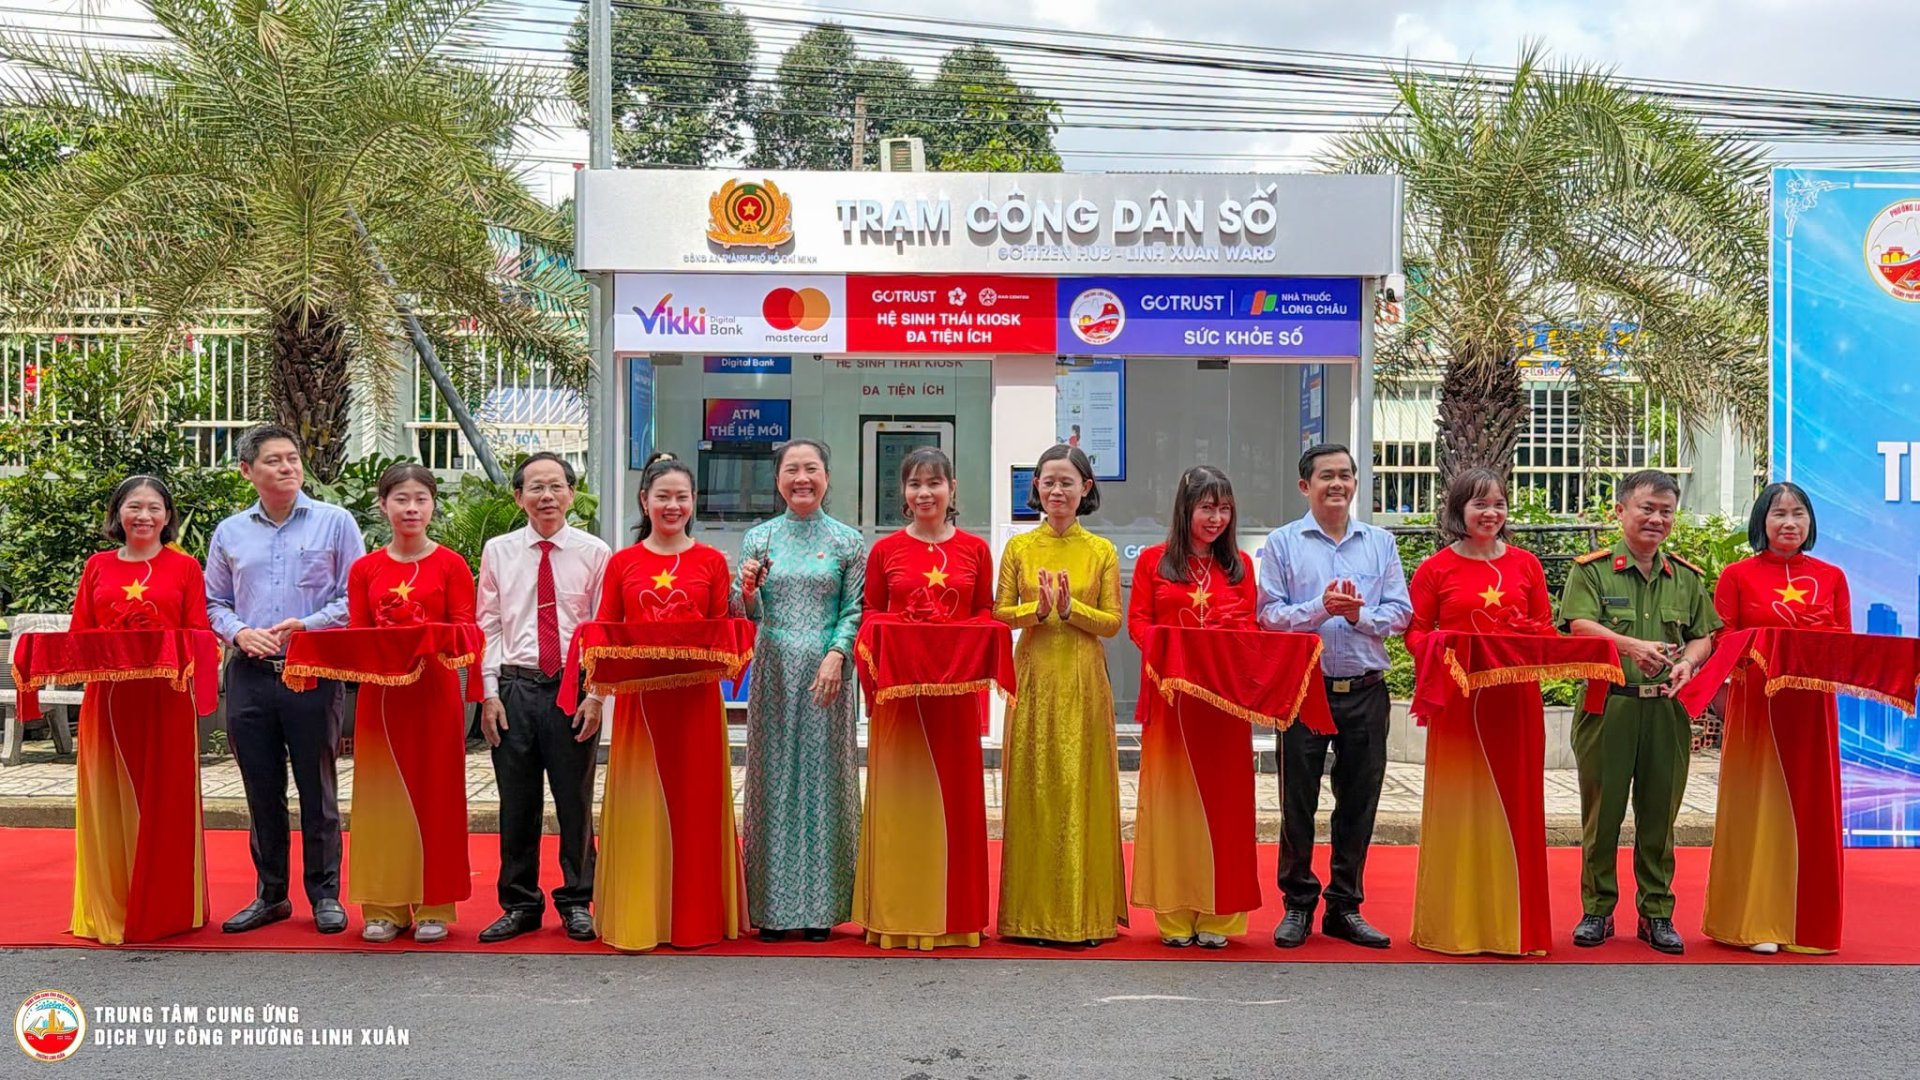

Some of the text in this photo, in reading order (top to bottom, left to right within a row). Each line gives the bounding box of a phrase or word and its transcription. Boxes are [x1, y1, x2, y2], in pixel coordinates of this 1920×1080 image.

[836, 182, 1278, 241] TRẠM CÔNG DÂN SỐ
[1224, 246, 1277, 262] WARD
[872, 290, 937, 303] GOTRUST
[1140, 294, 1225, 311] GOTRUST
[1281, 290, 1332, 302] NHÀ THUỐC
[632, 293, 706, 335] Vikki
[1281, 302, 1348, 315] LONG CHÂU
[710, 315, 736, 325] Digital
[877, 310, 1021, 327] HỆ SINH THÁI KIOSK
[710, 323, 743, 335] Bank
[906, 327, 993, 345] ĐA TIỆN ÍCH
[1184, 325, 1303, 346] SỨC KHỎE SỐ
[765, 333, 829, 343] mastercard
[721, 357, 775, 368] Digital Bank
[862, 382, 945, 399] ĐA TIỆN ÍCH
[732, 409, 760, 420] ATM
[709, 421, 783, 440] THẾ HỆ MỚI
